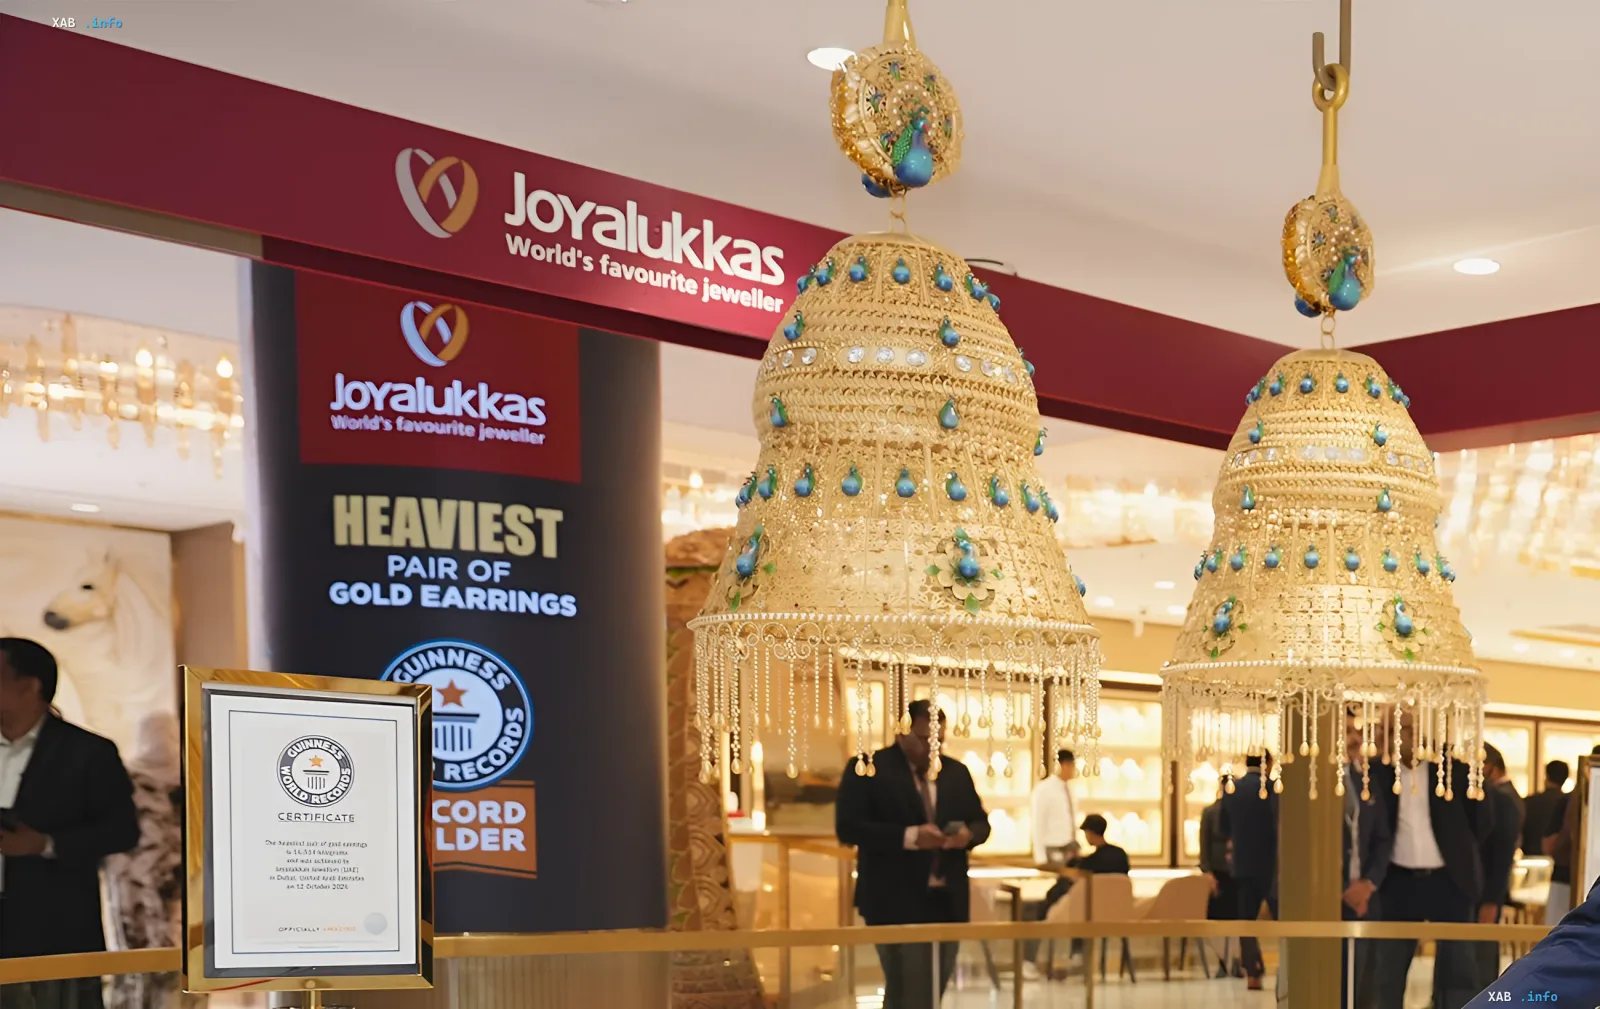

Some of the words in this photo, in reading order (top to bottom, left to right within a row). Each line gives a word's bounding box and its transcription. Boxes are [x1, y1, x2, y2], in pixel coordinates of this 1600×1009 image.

[504, 171, 785, 286] Joyalukkas
[505, 233, 594, 272] World's
[599, 253, 698, 295] favourite
[701, 277, 784, 313] jeweller
[330, 372, 546, 426] Joyalukkas
[330, 414, 393, 431] World's
[396, 416, 475, 438] favourite
[478, 423, 546, 445] jeweller
[333, 494, 564, 558] HEAVIEST
[387, 554, 458, 580] PAIR
[467, 559, 511, 583] OF
[329, 581, 413, 606] GOLD
[420, 584, 577, 618] EARRINGS
[392, 649, 512, 691] GUINNESS
[287, 739, 345, 760] GUINNESS
[443, 707, 525, 782] RECORDS
[280, 765, 308, 801] WORLD
[311, 767, 351, 804] RECORDS
[277, 812, 355, 822] CERTIFICATE
[432, 799, 526, 825] CORD
[435, 827, 527, 852] LDER
